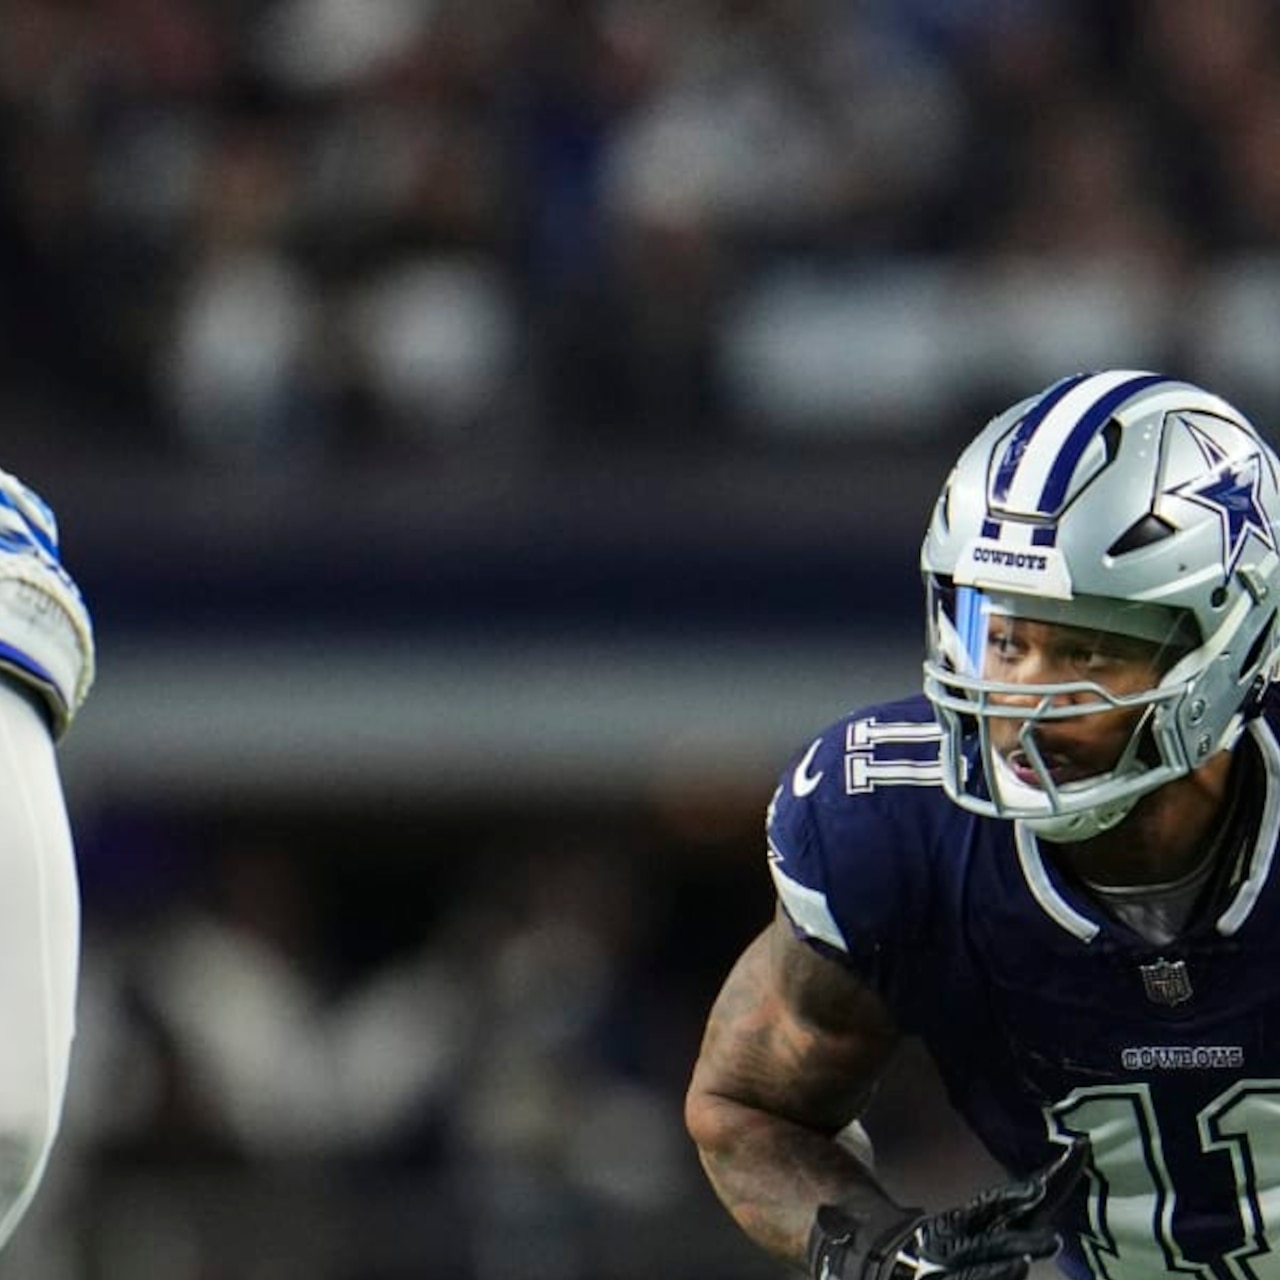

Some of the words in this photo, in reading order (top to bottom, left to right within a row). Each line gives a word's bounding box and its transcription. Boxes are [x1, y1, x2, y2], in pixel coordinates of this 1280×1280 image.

[973, 547, 1048, 571] COWBOYS
[844, 716, 969, 796] 11
[1121, 1046, 1245, 1070] COWBOYS
